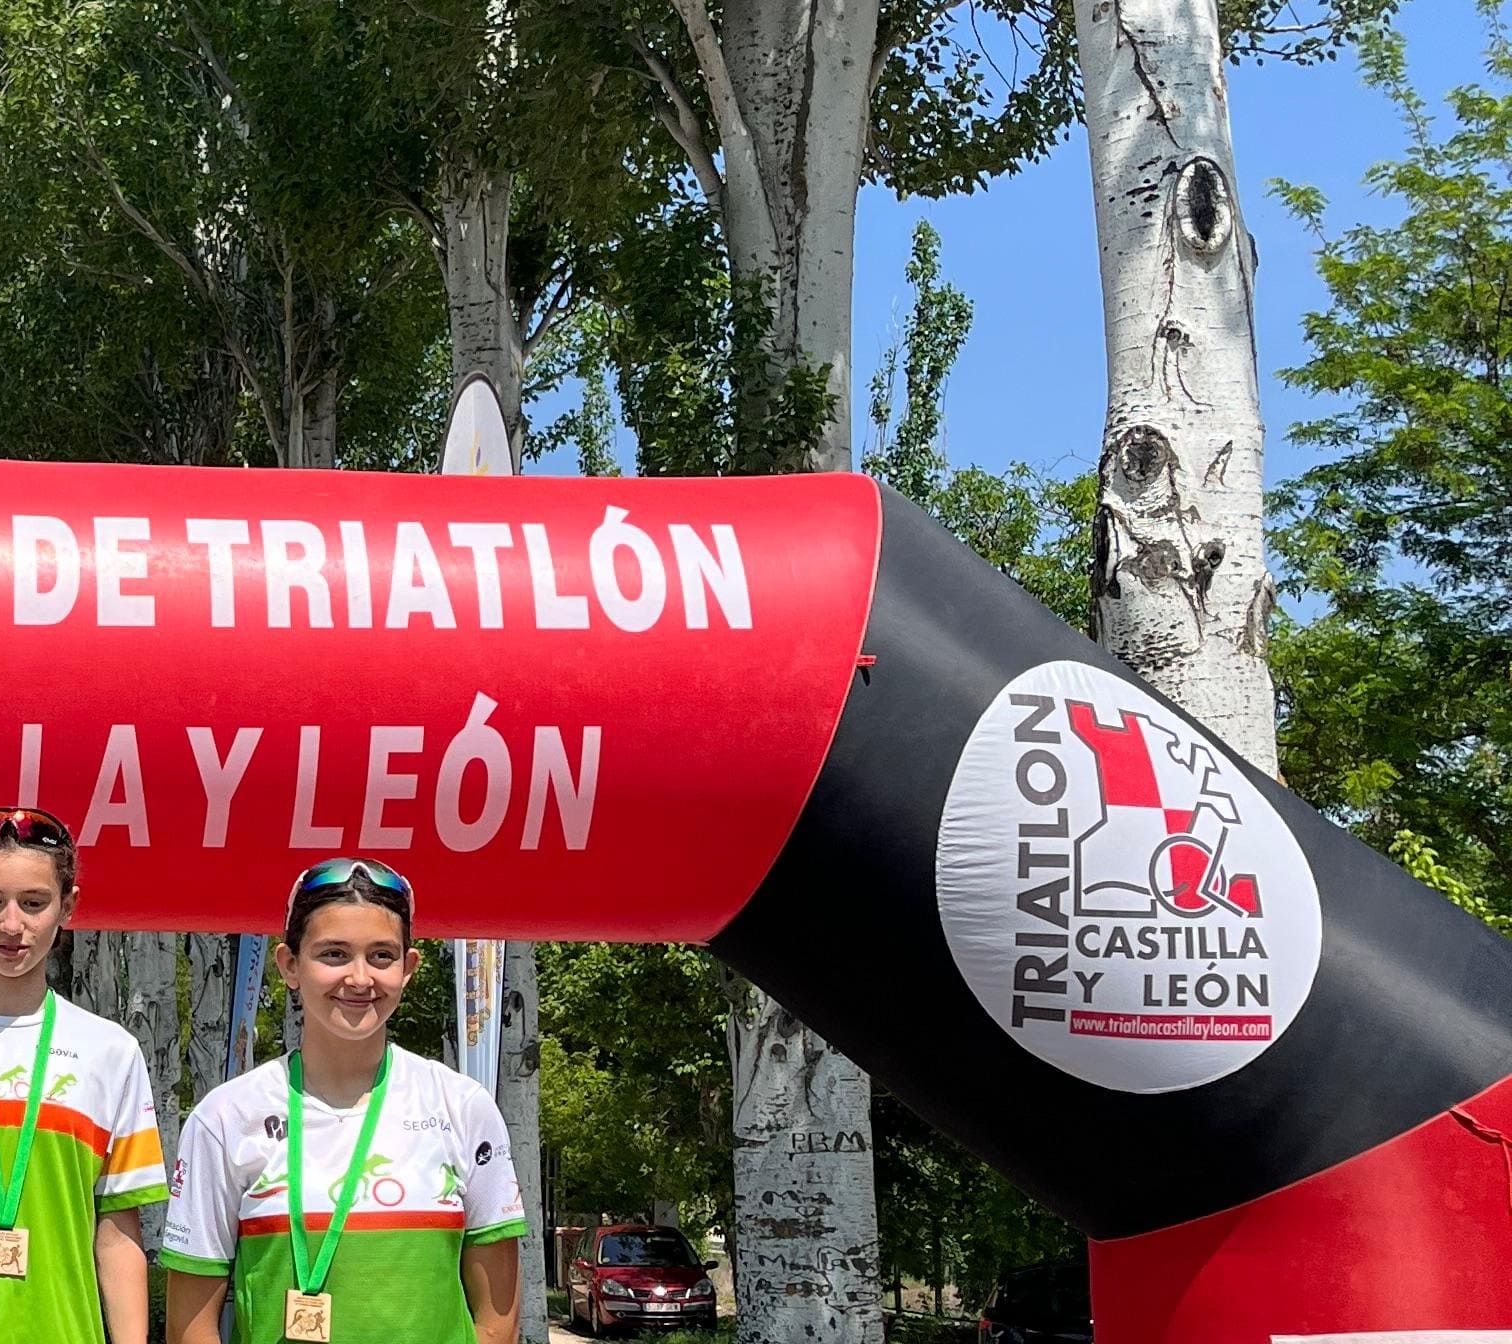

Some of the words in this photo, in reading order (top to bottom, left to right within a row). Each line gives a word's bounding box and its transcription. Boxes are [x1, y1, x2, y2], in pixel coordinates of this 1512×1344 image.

[13, 515, 155, 627] DE
[188, 504, 752, 632] TRIATLÓN
[186, 726, 264, 848] Y
[289, 691, 603, 853] LEÓN
[1009, 693, 1070, 1027] TRIATLON
[1072, 972, 1105, 1004] Y
[1143, 961, 1270, 1007] LEÓN
[1076, 924, 1269, 960] CASTILLA
[1073, 1017, 1270, 1039] www.triatloncastillayleon.com
